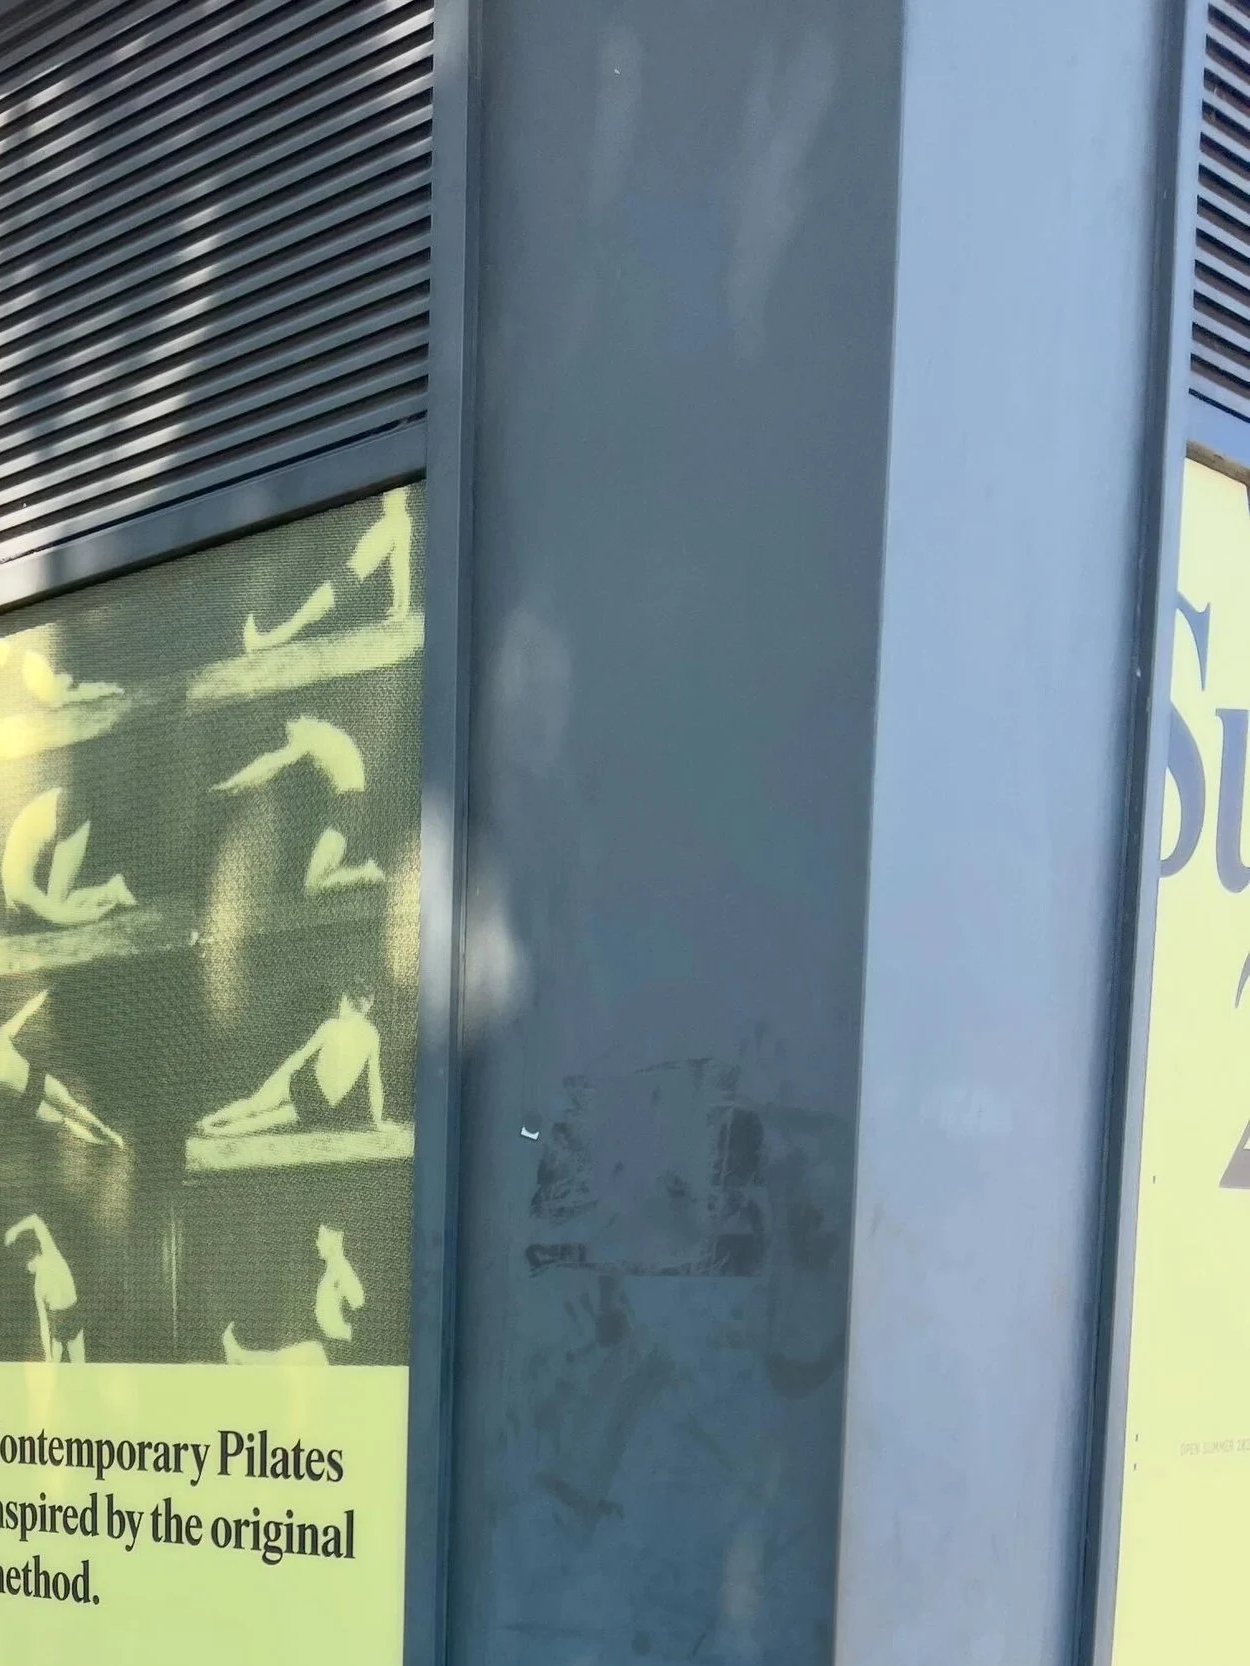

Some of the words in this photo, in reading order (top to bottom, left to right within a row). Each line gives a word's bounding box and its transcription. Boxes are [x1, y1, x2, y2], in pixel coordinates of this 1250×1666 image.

[217, 1429, 345, 1484] Pilates
[106, 1493, 145, 1552] by
[150, 1498, 204, 1546] the
[210, 1509, 356, 1566] original
